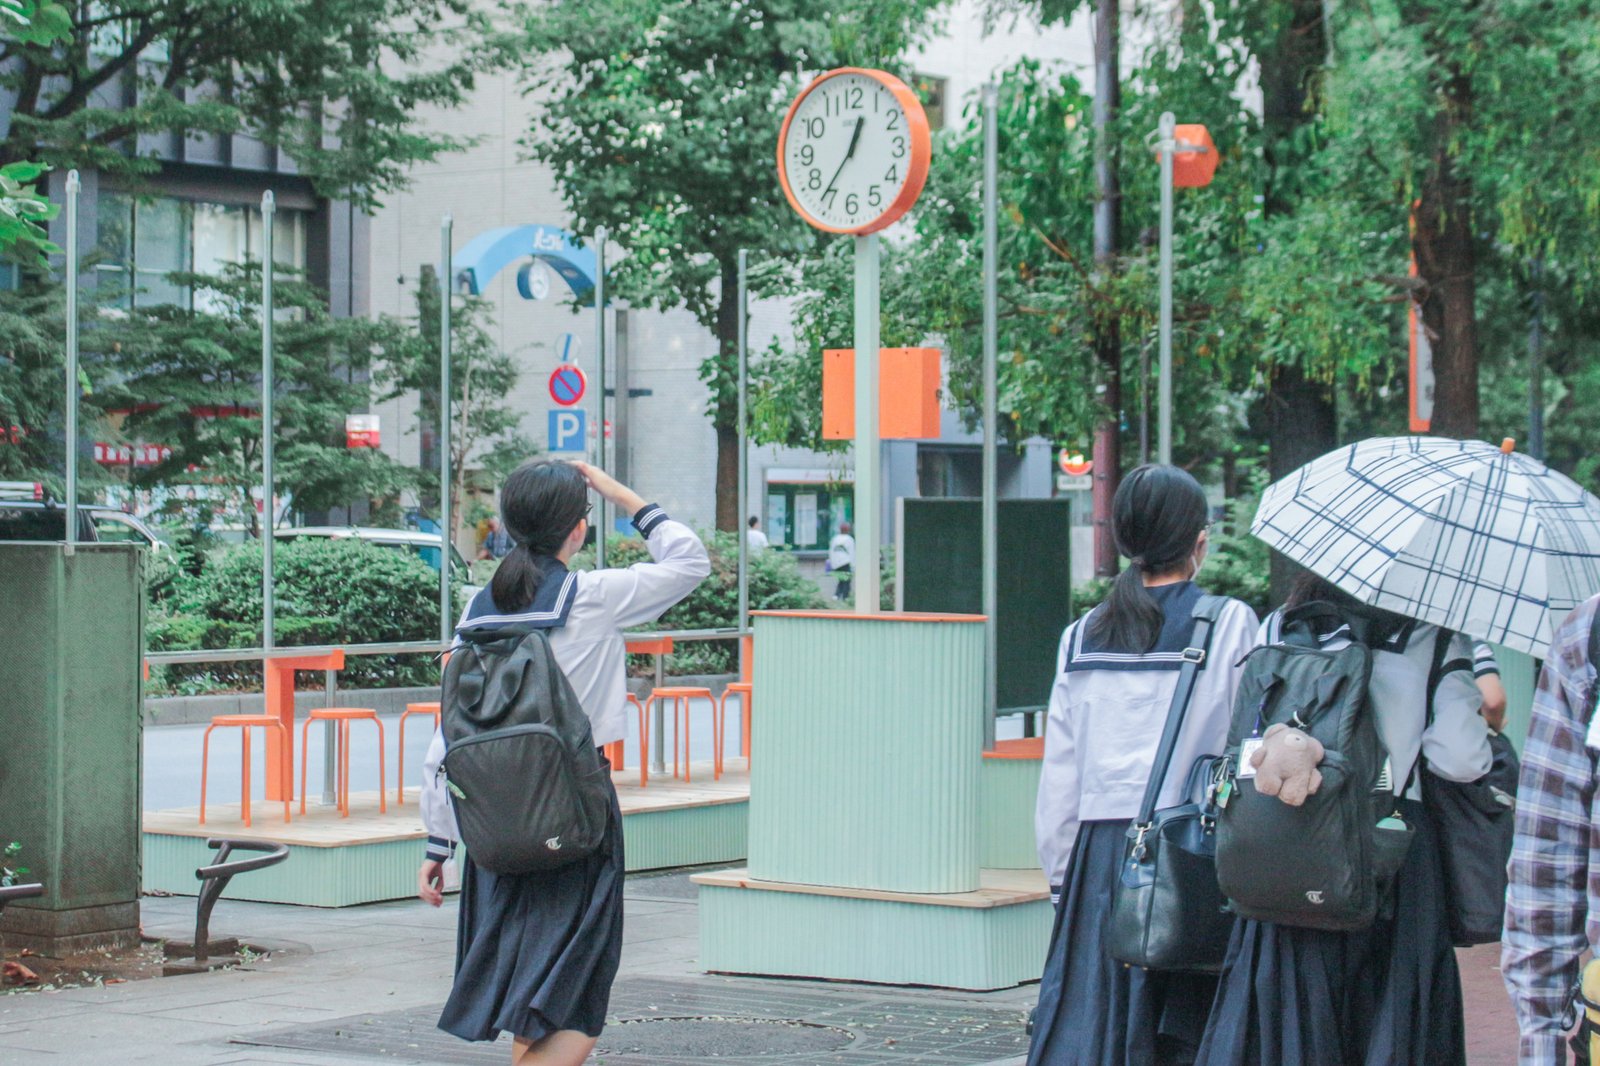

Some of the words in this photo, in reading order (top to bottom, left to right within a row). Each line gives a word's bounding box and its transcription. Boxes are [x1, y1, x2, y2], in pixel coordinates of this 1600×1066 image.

[825, 95, 839, 117] 11
[845, 87, 863, 110] 12
[873, 91, 878, 113] 1
[806, 117, 825, 139] 10
[886, 109, 899, 131] 2
[800, 144, 814, 166] 9
[892, 136, 905, 158] 3
[808, 168, 822, 190] 8
[885, 165, 897, 184] 4
[827, 188, 838, 210] 7
[845, 193, 859, 215] 6
[868, 185, 881, 207] 5
[557, 413, 580, 449] P
